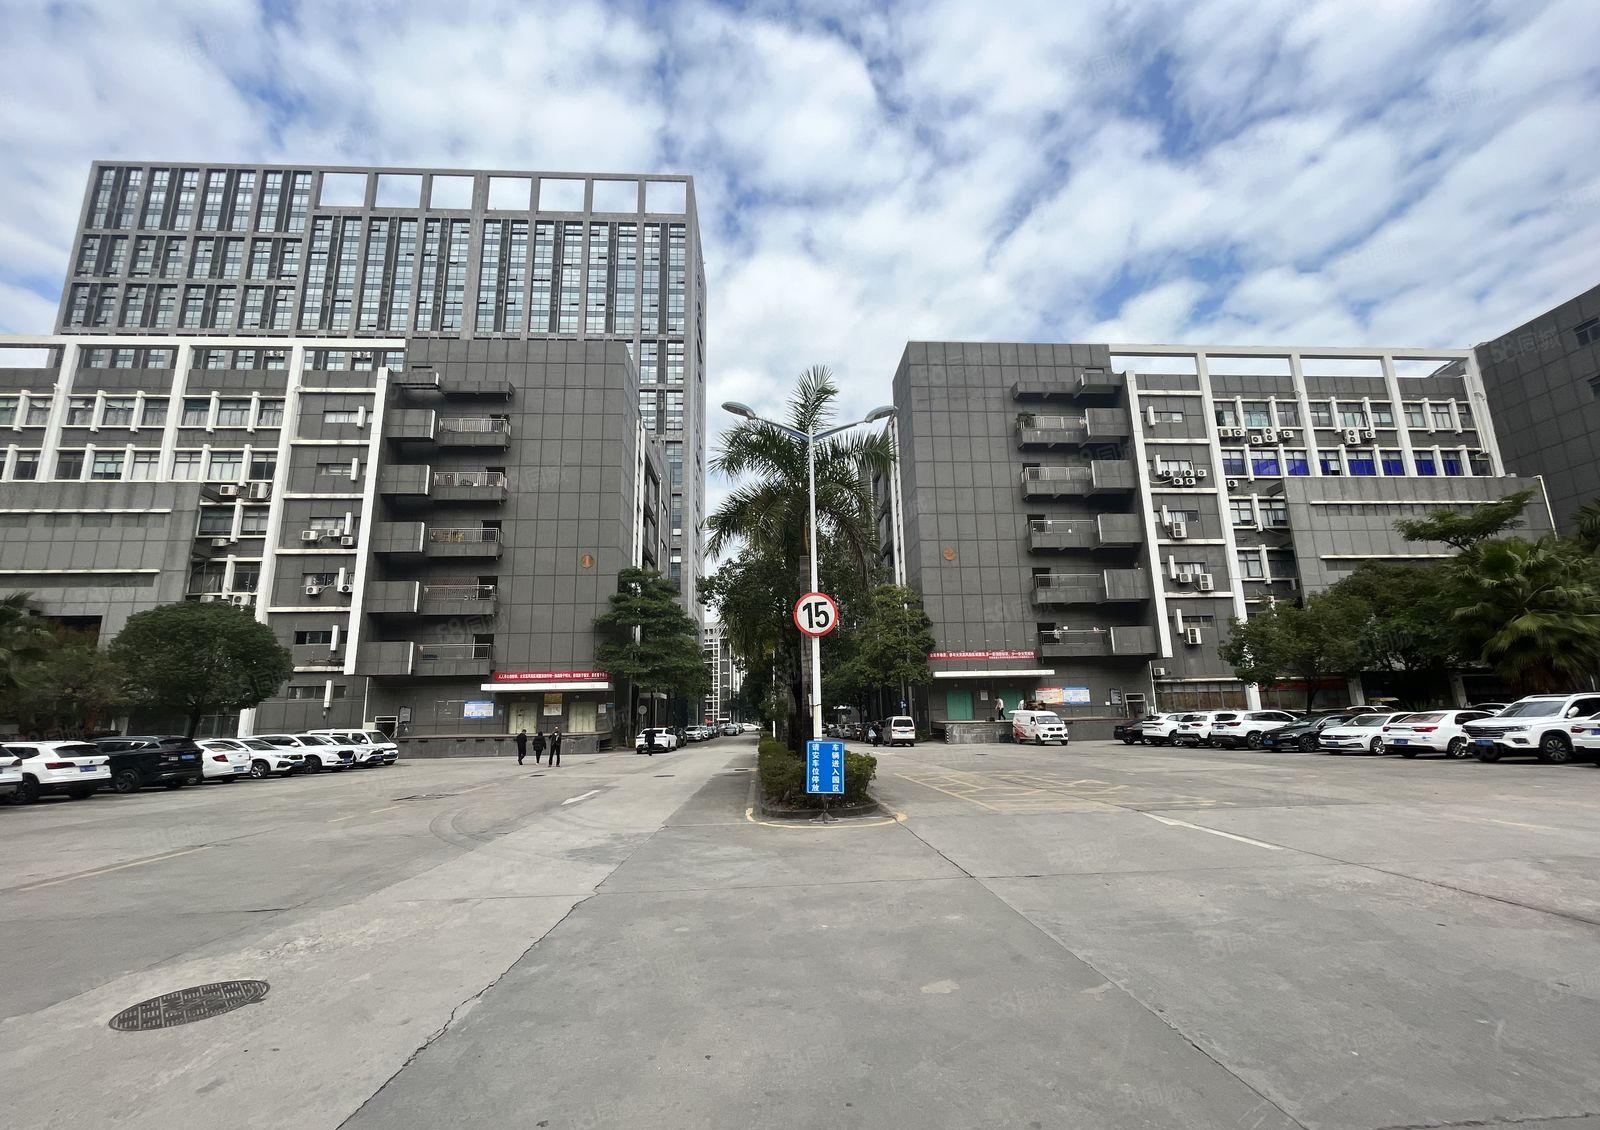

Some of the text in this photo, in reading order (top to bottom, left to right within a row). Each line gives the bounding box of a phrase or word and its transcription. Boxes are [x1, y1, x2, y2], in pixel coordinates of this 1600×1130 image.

[802, 601, 830, 629] 15
[831, 743, 840, 792] 车辆进入园区
